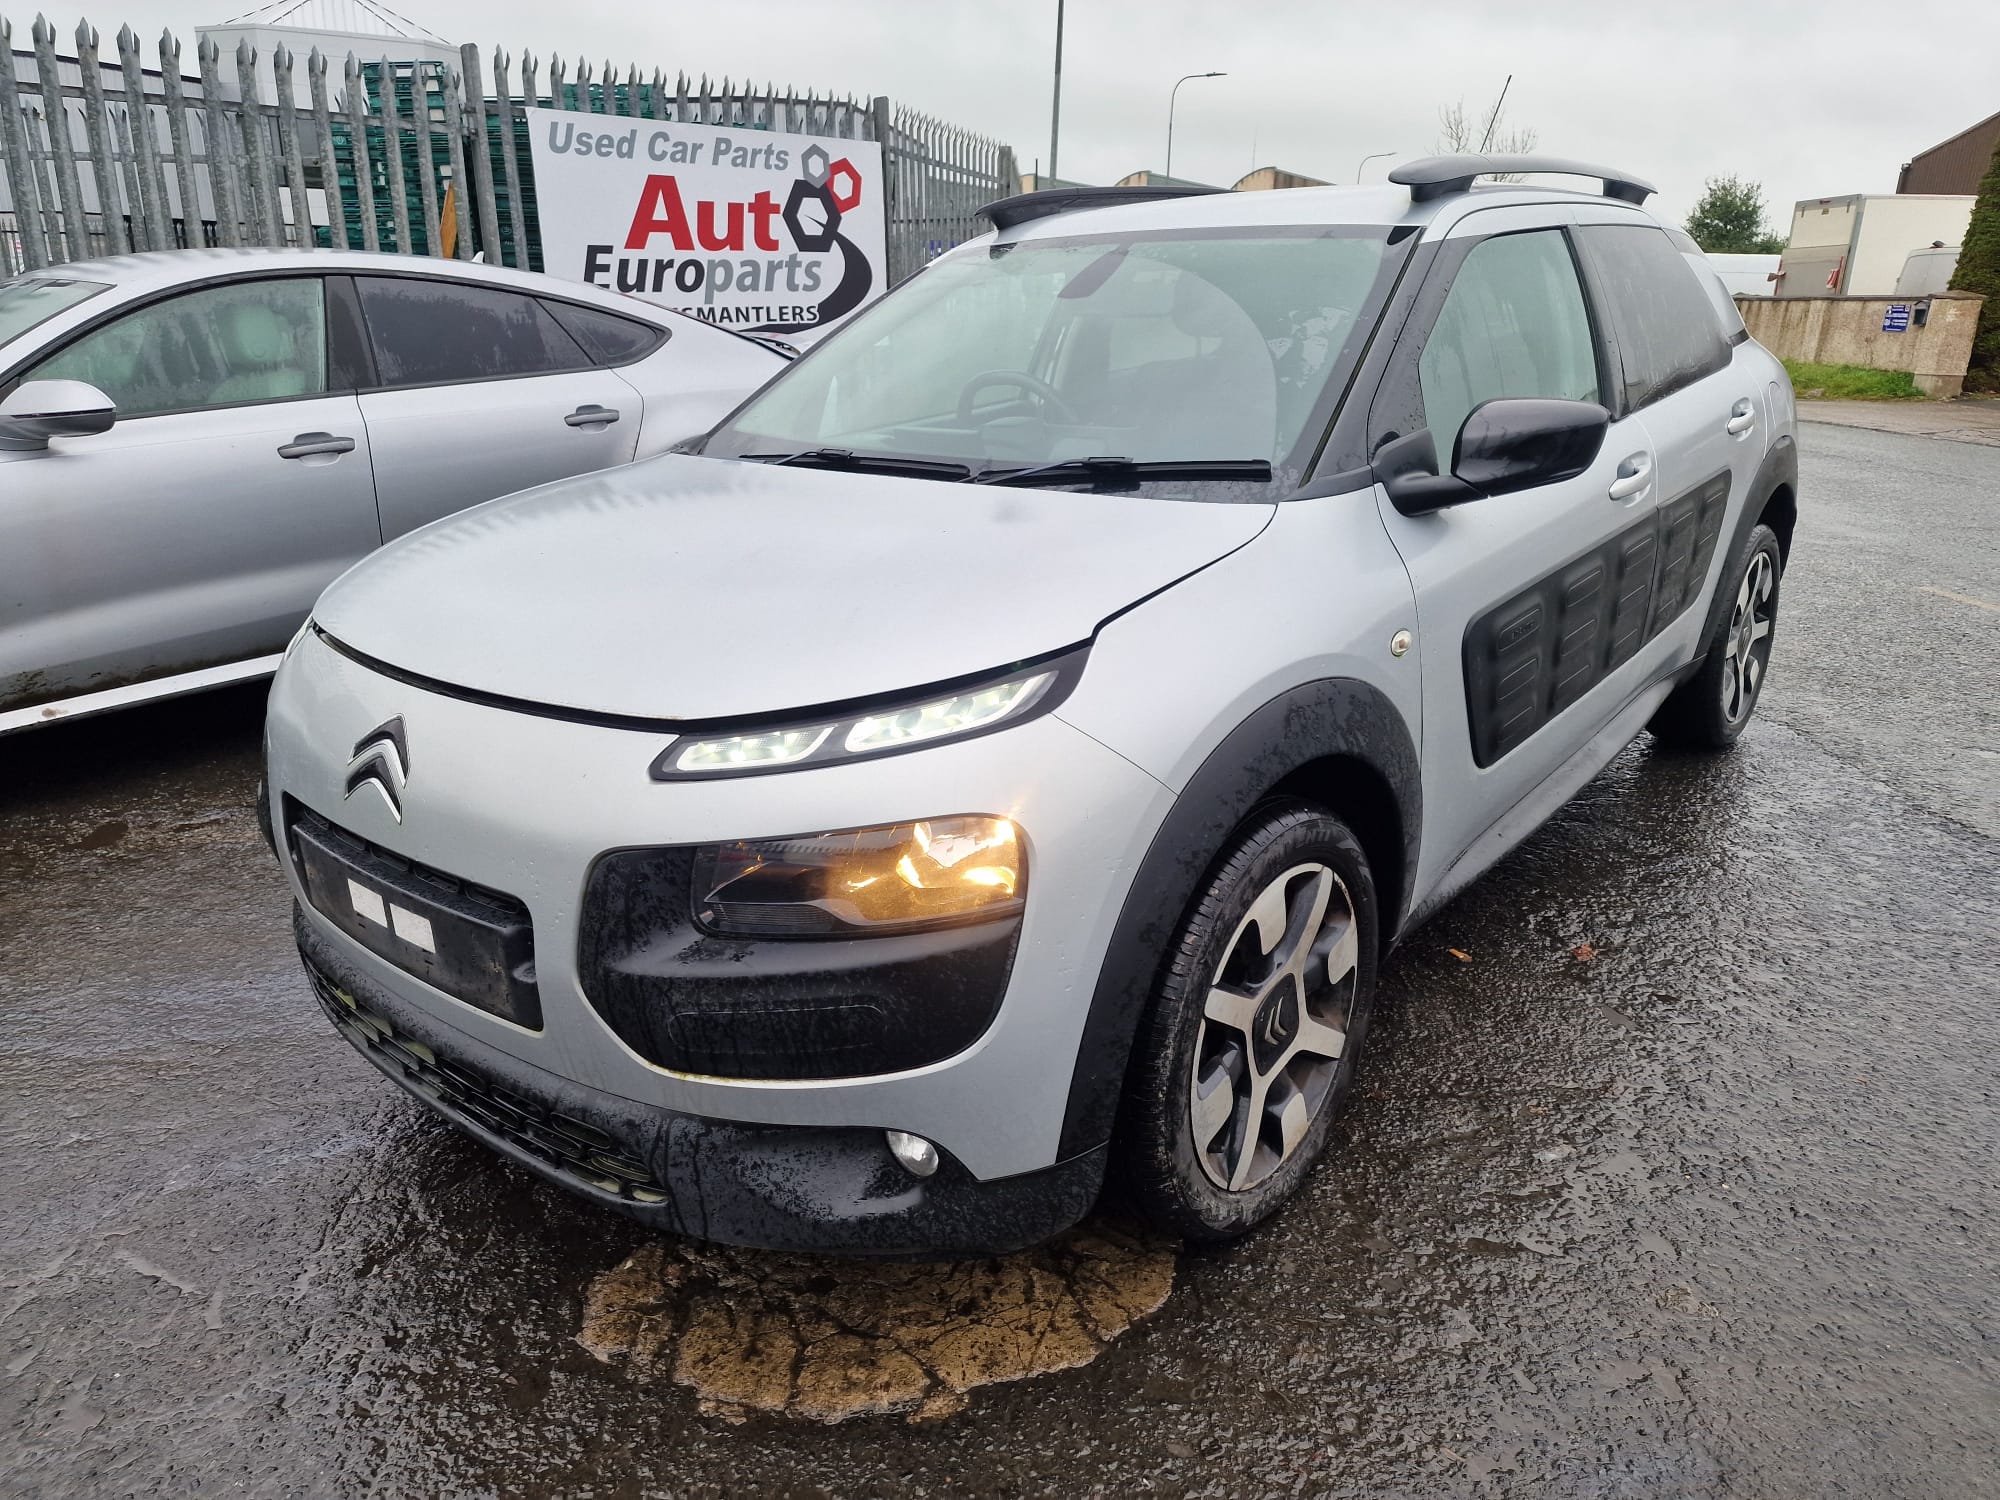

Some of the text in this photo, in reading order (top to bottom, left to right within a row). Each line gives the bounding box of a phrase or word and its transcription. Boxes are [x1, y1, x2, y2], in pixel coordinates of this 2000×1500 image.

[548, 121, 789, 171] Used Car Parts
[584, 244, 822, 304] Europarts
[672, 305, 818, 324] MANTLERS
